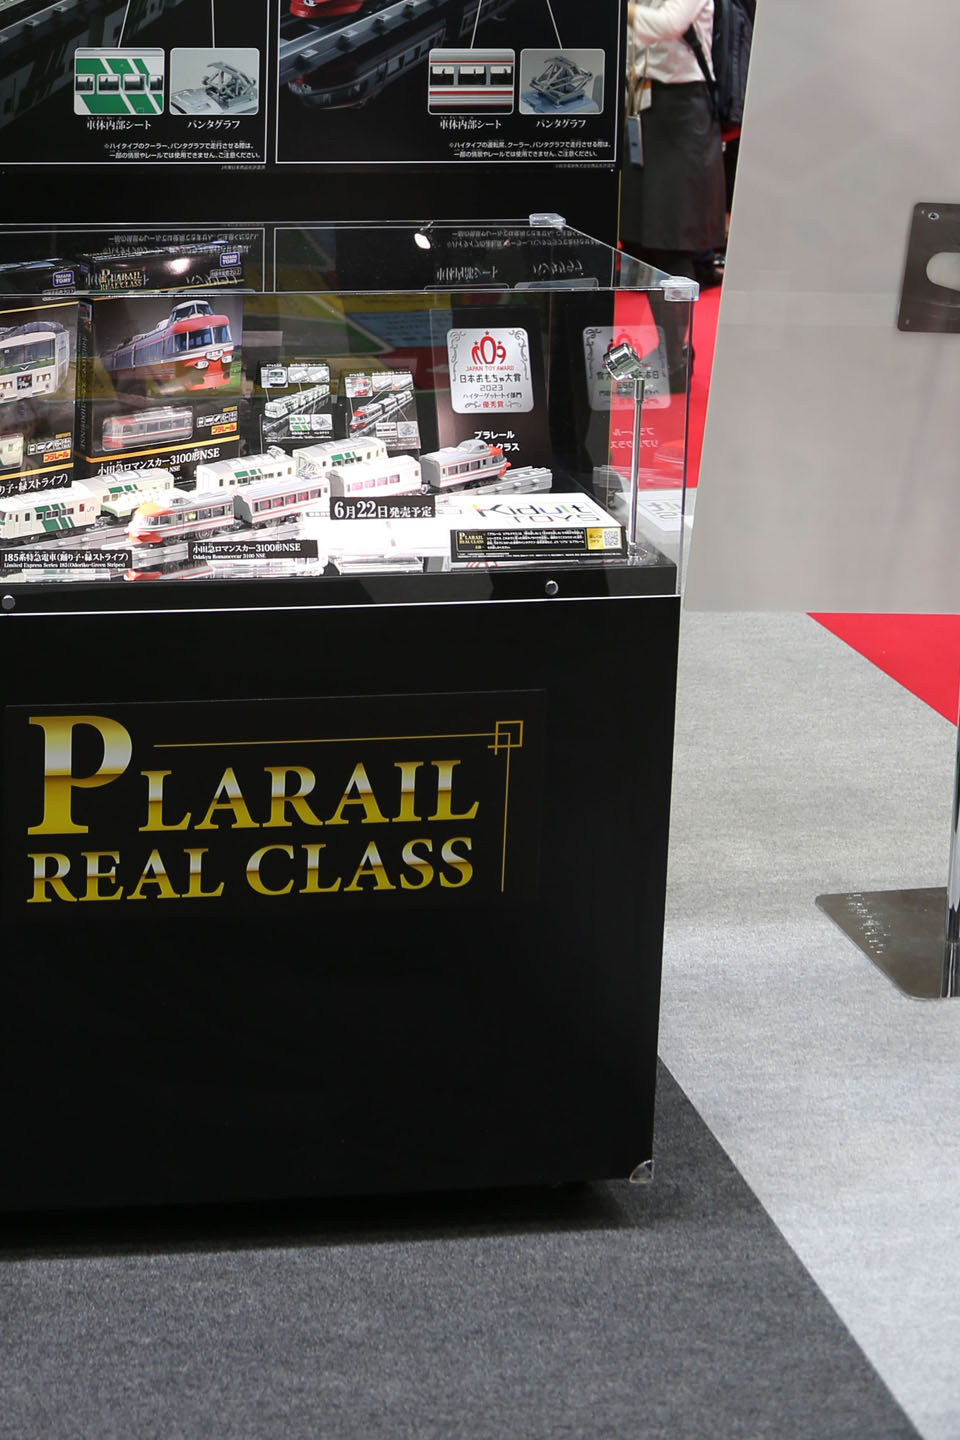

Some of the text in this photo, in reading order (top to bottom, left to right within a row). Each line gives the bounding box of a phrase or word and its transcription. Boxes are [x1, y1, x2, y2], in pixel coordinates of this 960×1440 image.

[86, 119, 152, 130] 車体内部シート
[187, 120, 240, 130] パンタグラフ
[440, 118, 502, 130] 車体内部シート
[536, 118, 586, 129] パンタグラフ
[459, 373, 521, 383] 日本おもちゃ大賞
[480, 384, 504, 392] 2023
[474, 430, 515, 440] プラレール
[334, 500, 432, 518] 6月22日発売予定
[473, 504, 593, 517] Kidult
[27, 715, 480, 835] PLARAIL
[27, 836, 474, 903] REAL CLASS
